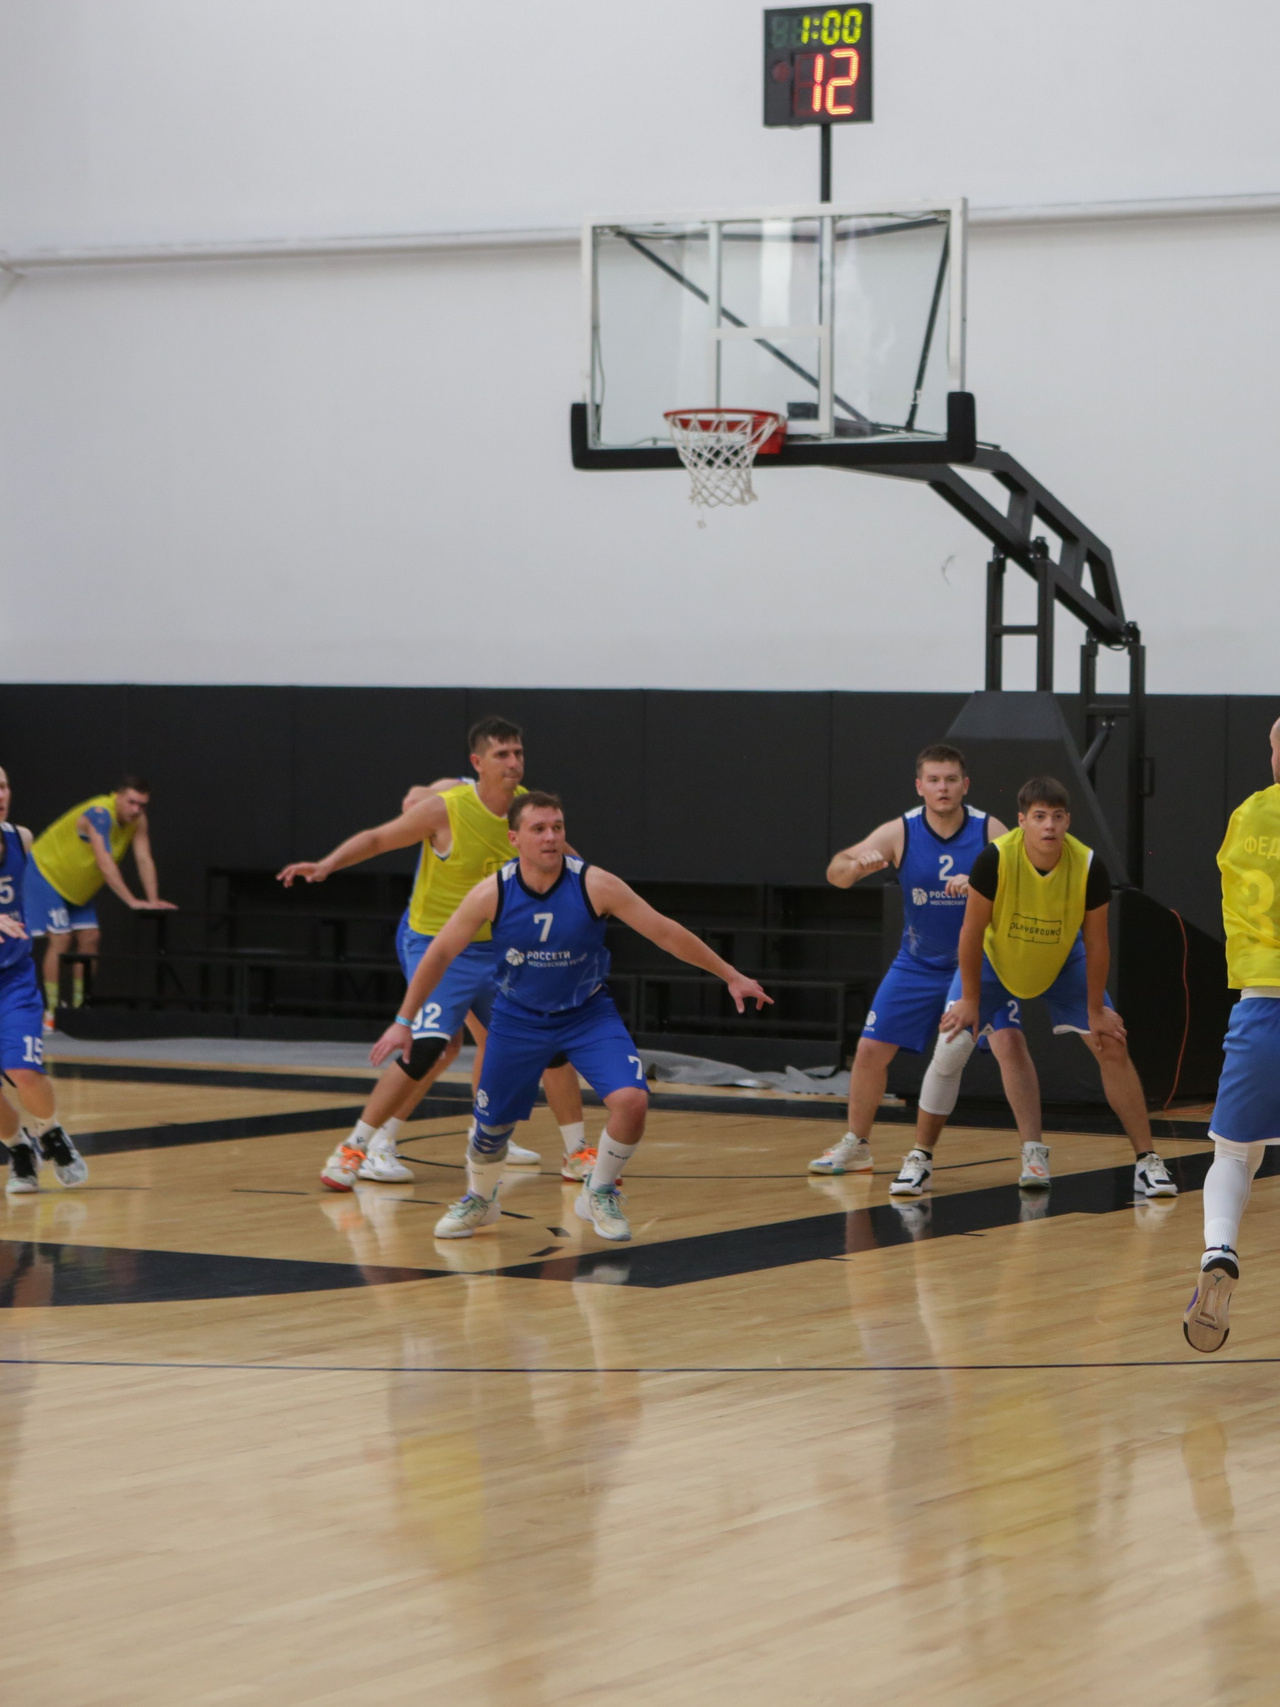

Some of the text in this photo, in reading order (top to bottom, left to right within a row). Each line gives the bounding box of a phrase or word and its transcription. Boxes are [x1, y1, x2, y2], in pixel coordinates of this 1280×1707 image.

[801, 8, 863, 45] 1:00
[812, 47, 859, 115] 12
[939, 854, 954, 881] 2
[533, 912, 554, 942] 7
[527, 951, 571, 961] РОССЕТИ
[1007, 1000, 1020, 1024] 2
[627, 1055, 643, 1080] 7
